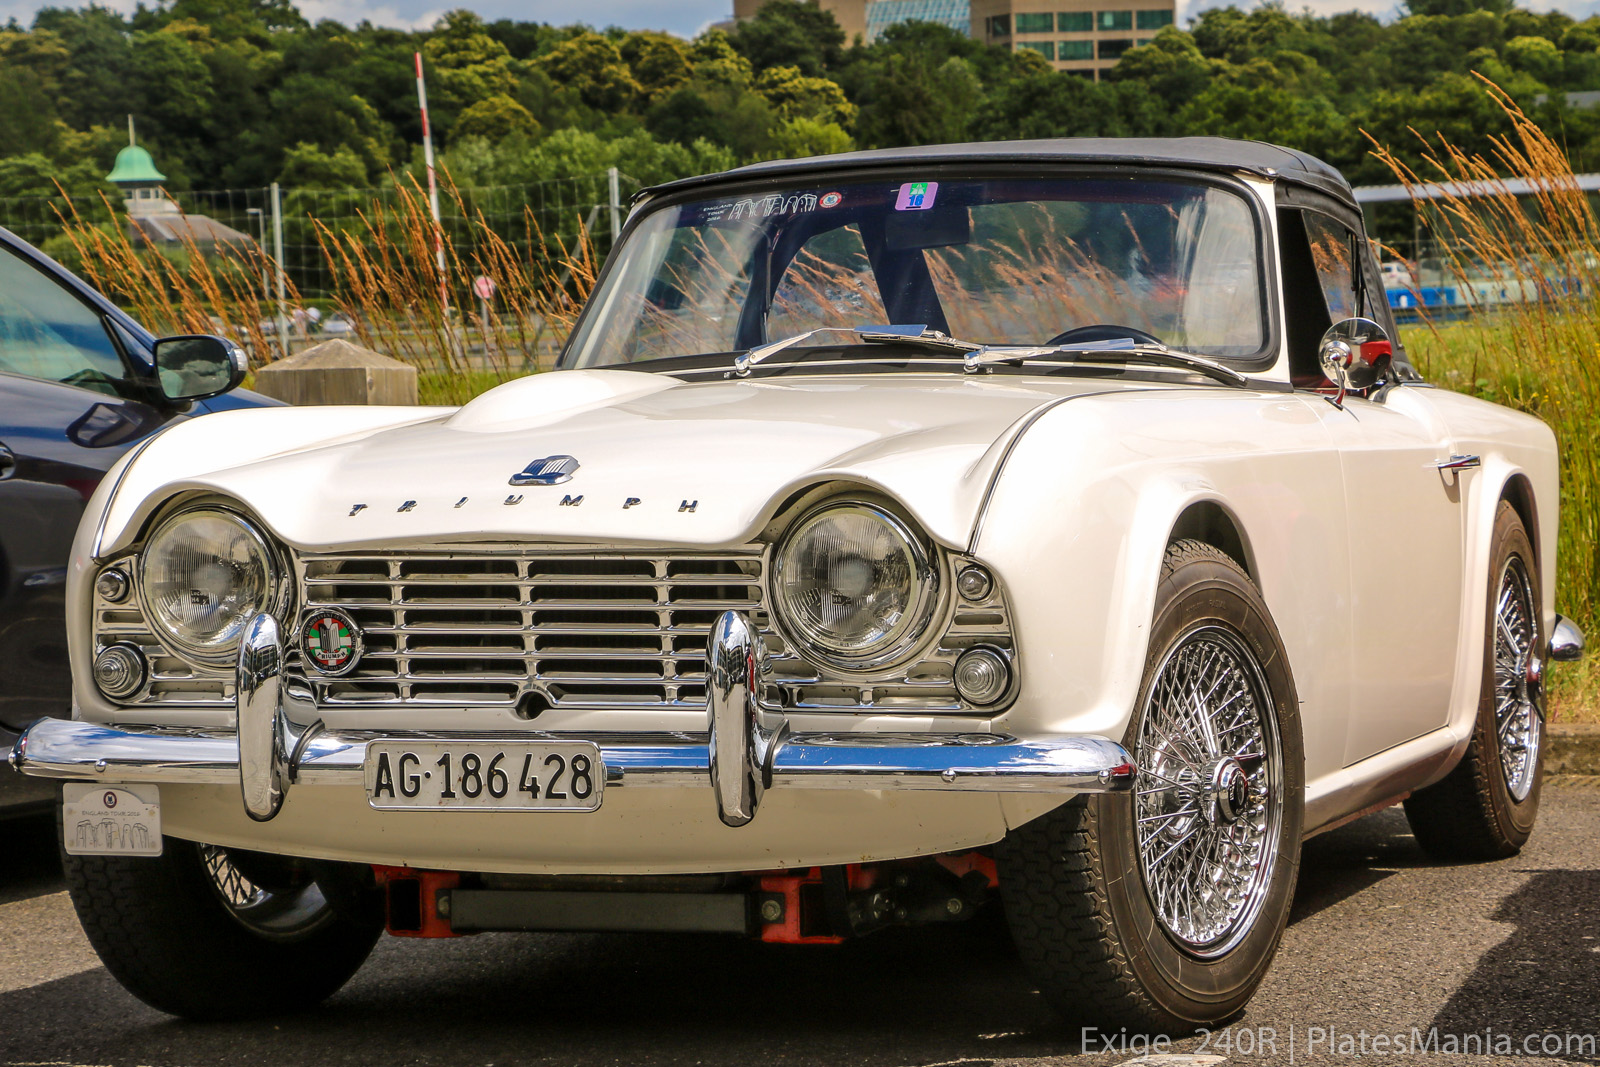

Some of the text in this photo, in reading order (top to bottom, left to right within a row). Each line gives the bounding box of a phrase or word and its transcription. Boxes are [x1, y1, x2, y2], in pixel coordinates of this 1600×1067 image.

[909, 194, 924, 206] 16
[349, 494, 699, 516] TRIUMPH
[317, 651, 346, 659] TRIUMPH
[518, 753, 594, 800] 428
